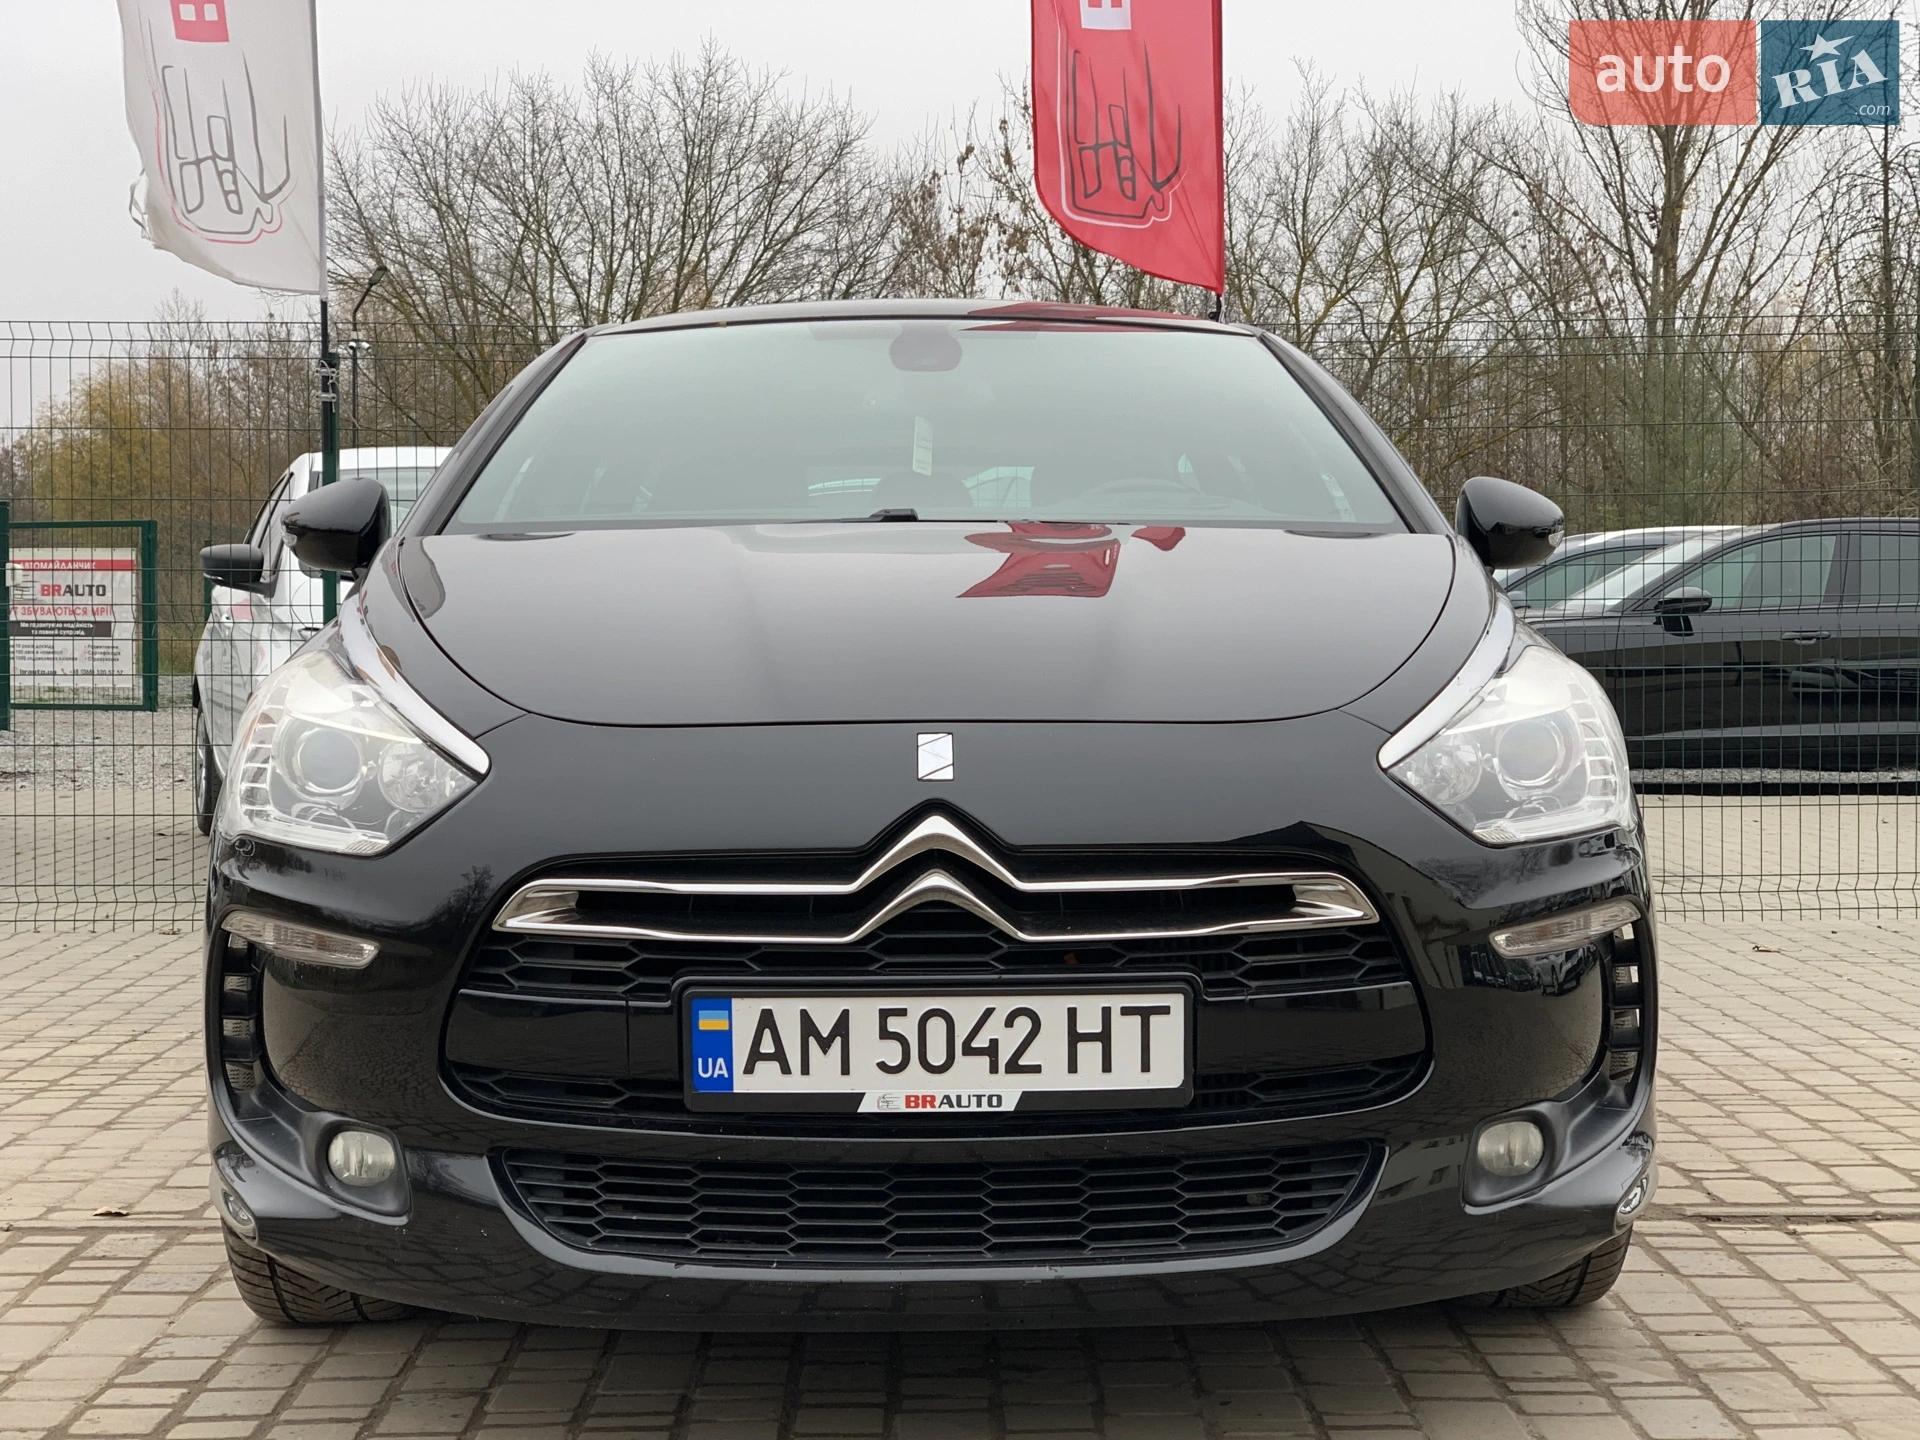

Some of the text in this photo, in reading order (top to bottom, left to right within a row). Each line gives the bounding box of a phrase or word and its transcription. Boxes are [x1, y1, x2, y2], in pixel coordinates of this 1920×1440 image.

[40, 584, 107, 597] BRAUTO
[21, 606, 87, 617] ЗБУВАЮТЬСЯ
[742, 1005, 1172, 1076] AM 5042 HT
[697, 1057, 729, 1079] UA
[904, 1093, 1003, 1110] BRAUTO
